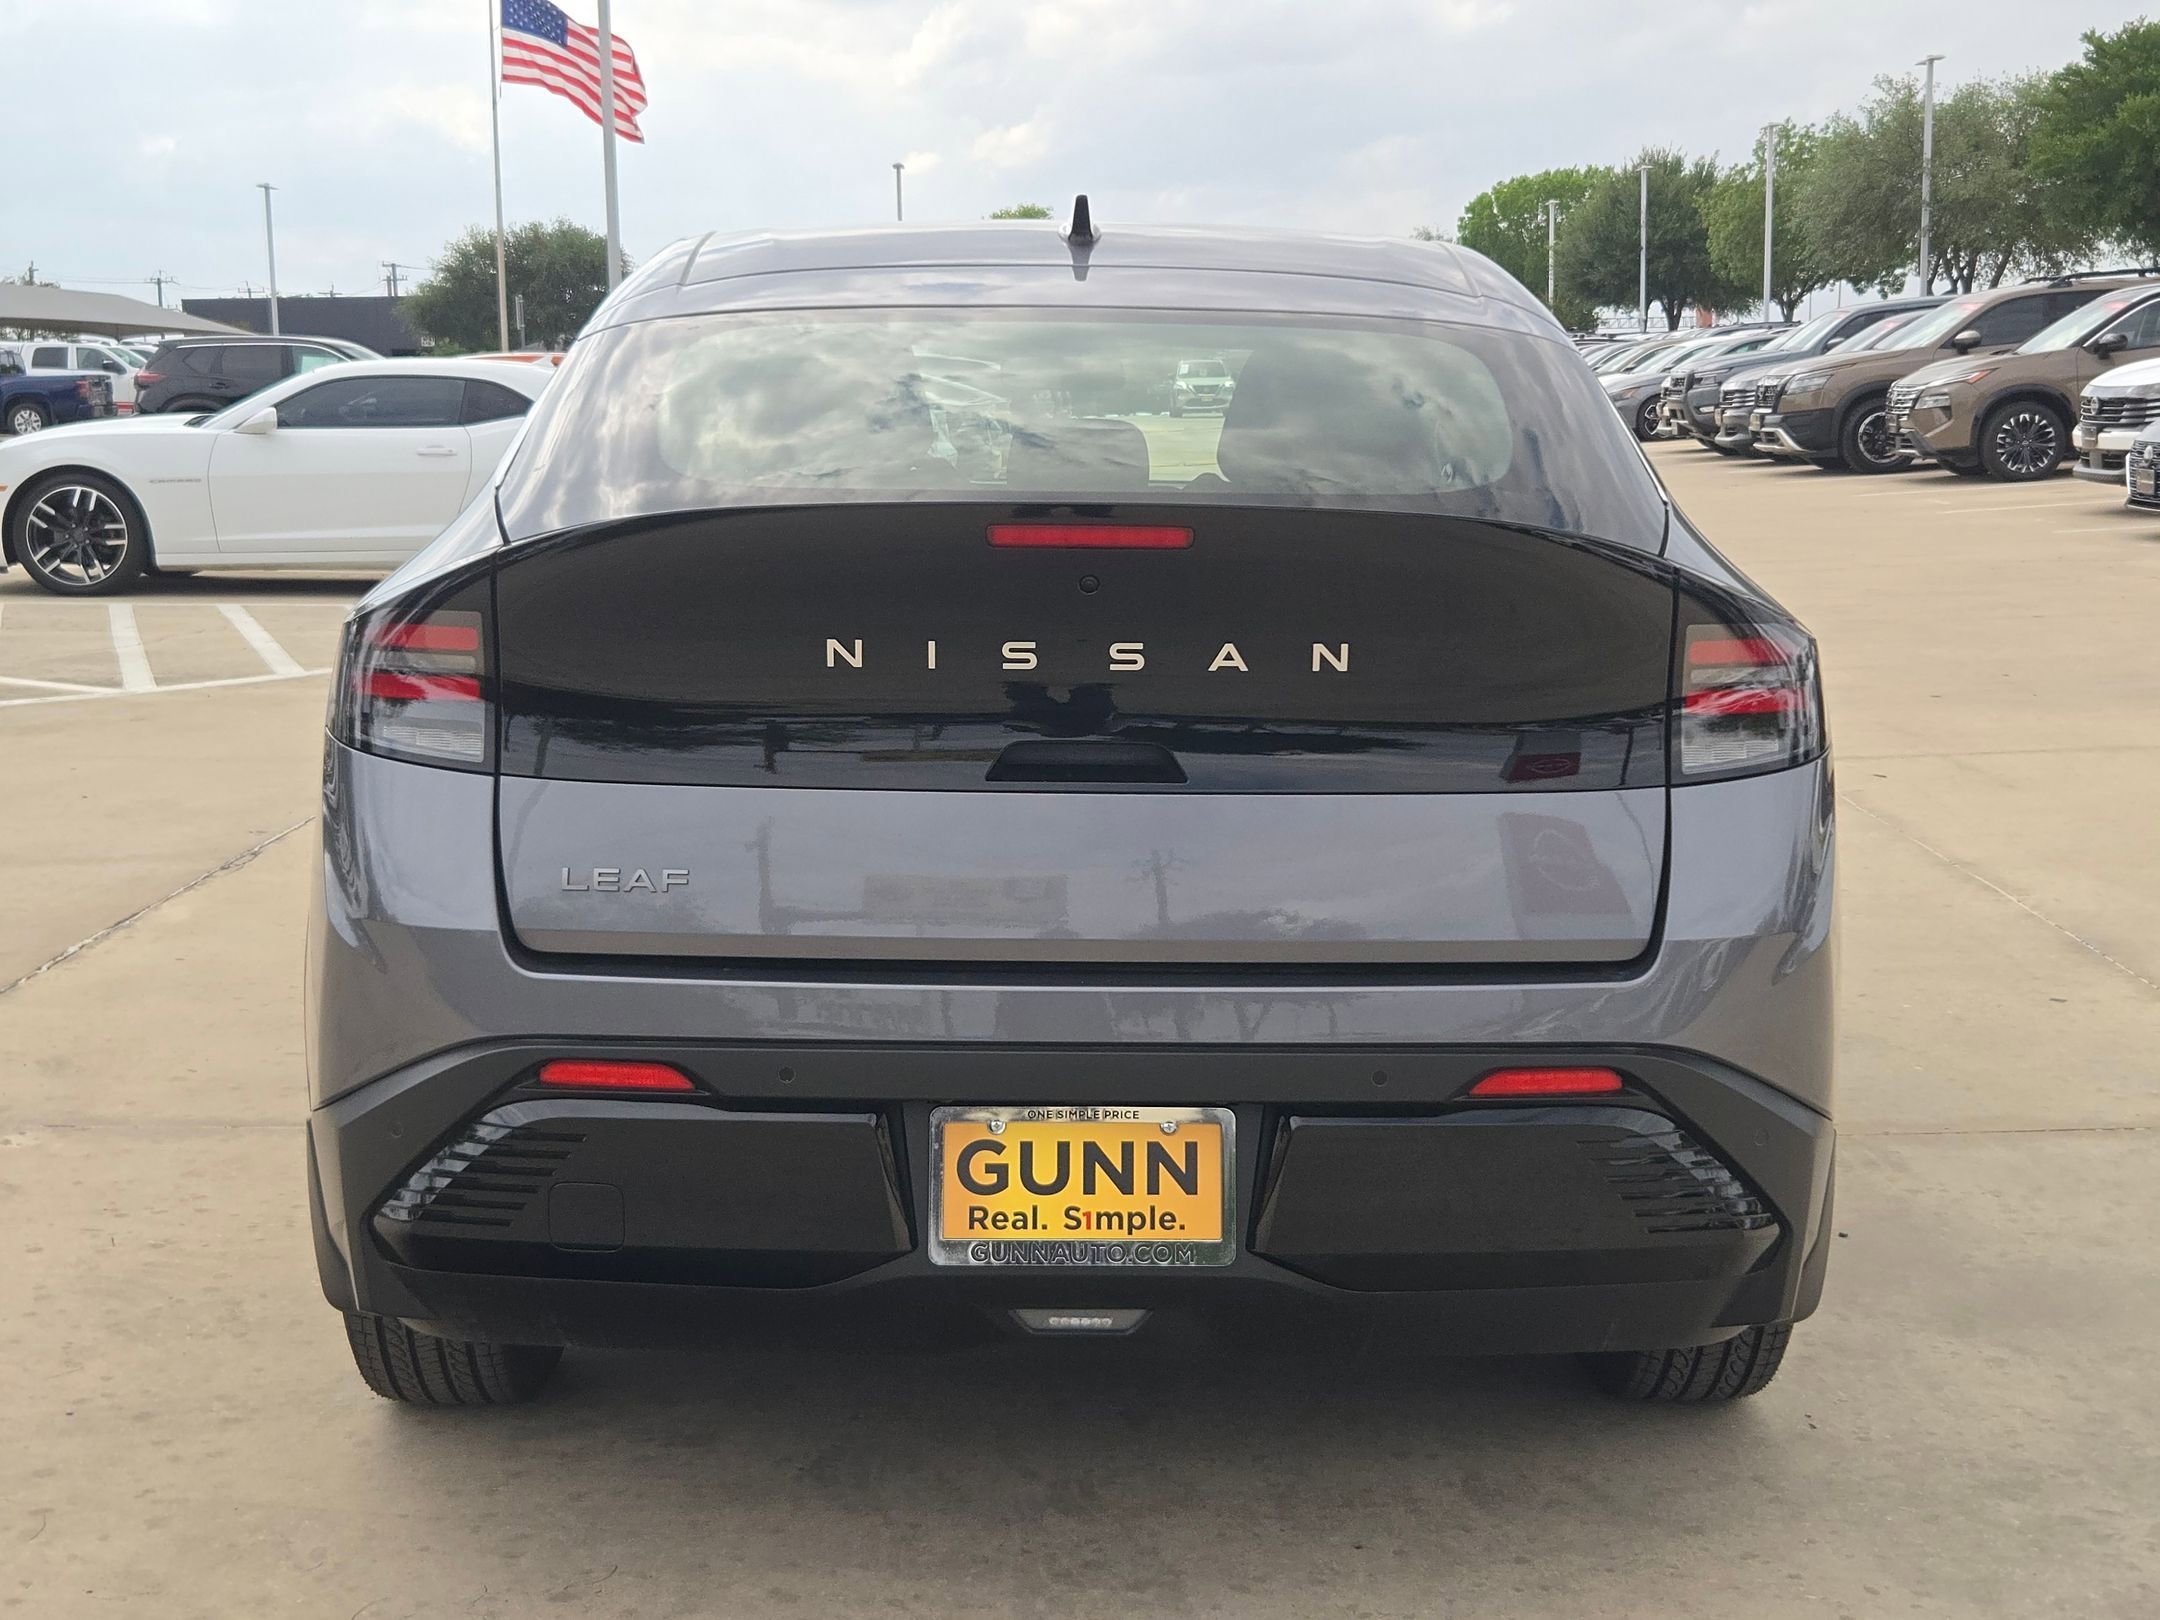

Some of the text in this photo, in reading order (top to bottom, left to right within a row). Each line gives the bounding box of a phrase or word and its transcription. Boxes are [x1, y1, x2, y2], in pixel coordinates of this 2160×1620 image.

[825, 638, 1349, 672] NISSAN
[561, 867, 689, 893] LEAF
[1027, 1109, 1140, 1120] ONE SIMPLE PRICE
[956, 1139, 1198, 1196] GUNN
[968, 1205, 1048, 1230] Real.
[970, 1241, 1195, 1265] GUNNAUTO.COM
